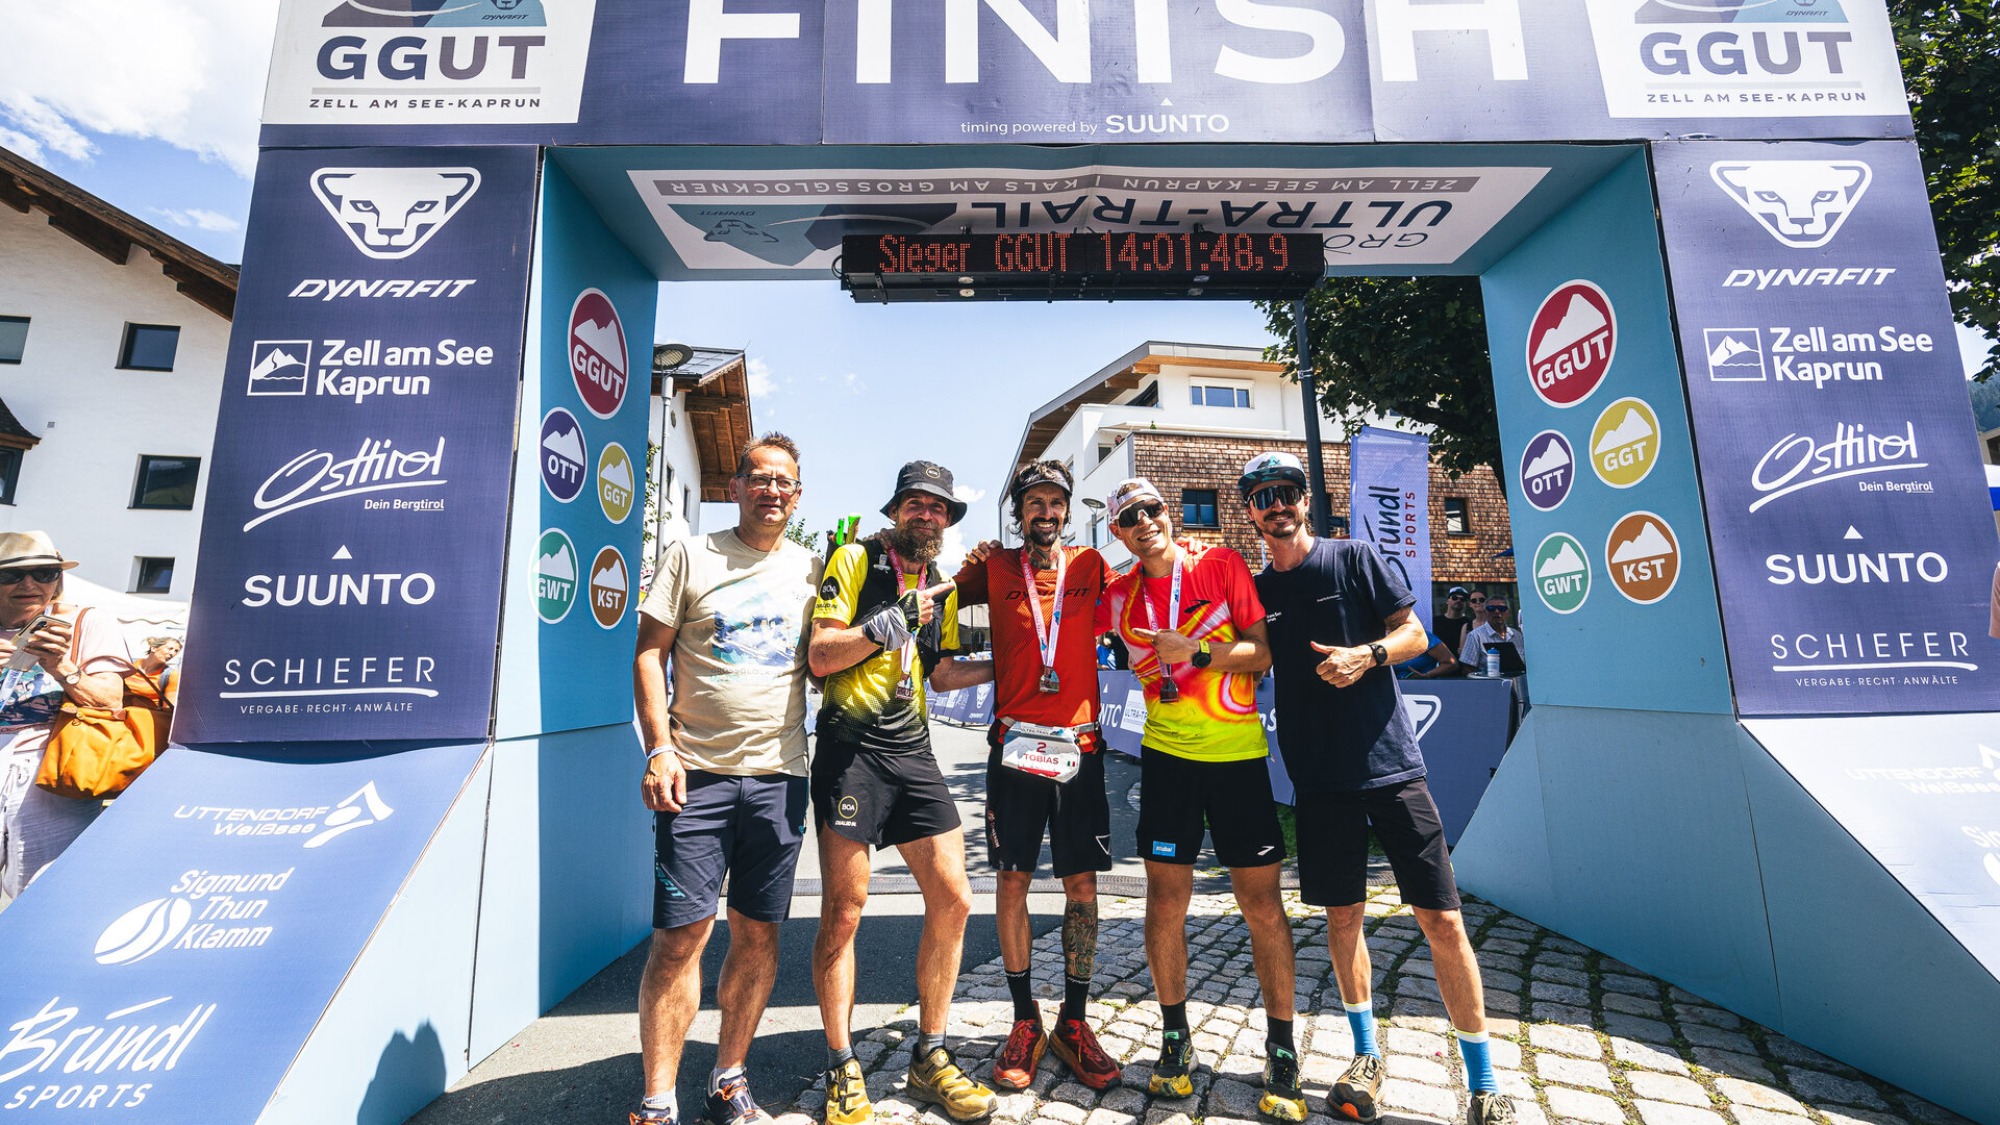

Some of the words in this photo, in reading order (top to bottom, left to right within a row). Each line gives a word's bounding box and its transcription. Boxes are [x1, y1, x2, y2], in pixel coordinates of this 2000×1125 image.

[684, 0, 1528, 84] FINISH
[1640, 31, 1852, 75] GGUT
[316, 35, 546, 81] GGUT
[310, 98, 358, 109] ZELL
[369, 98, 398, 108] AM
[408, 98, 541, 108] SEE-KAPRUN
[1647, 94, 1693, 103] ZELL
[1703, 94, 1731, 103] AM
[1740, 92, 1867, 103] SEE-KAPRUN
[961, 119, 1007, 137] timing
[1012, 119, 1075, 137] powered
[1079, 119, 1098, 137] by
[1105, 114, 1229, 134] SUUNTO
[671, 180, 934, 195] GROSSGLOCKNER
[949, 180, 990, 193] AM
[1005, 177, 1077, 193] KALS
[1122, 177, 1318, 191] SEE-KAPRUN
[1332, 178, 1375, 190] AM
[1387, 178, 1457, 191] ZELL
[972, 196, 1453, 229] ULTRA-TRAIL
[879, 234, 971, 273] Sieger
[995, 233, 1070, 272] GGUT
[288, 279, 477, 301] DYNAFIT
[1721, 267, 1896, 291] DYNAFIT
[1770, 327, 1828, 352] Zell
[1833, 331, 1877, 352] am
[1881, 326, 1933, 352] See
[319, 340, 379, 366] Zell
[384, 345, 431, 365] am
[436, 339, 493, 366] See
[1536, 335, 1610, 391] GGUT
[572, 344, 625, 403] GGUT
[1771, 355, 1883, 389] Kaprun
[315, 368, 431, 403] Kaprun
[1603, 441, 1648, 471] GGT
[548, 455, 579, 484] OTT
[1531, 469, 1565, 495] OTT
[603, 488, 628, 509] GGT
[1859, 481, 1883, 492] Dein
[1886, 481, 1933, 494] Bergtirol
[365, 499, 390, 511] Dein
[393, 499, 444, 513] Bergtirol
[1405, 492, 1417, 558] SPORTS
[1622, 558, 1665, 584] KST
[1766, 552, 1948, 584] SUUNTO
[242, 571, 435, 606] SUUNTO
[535, 575, 571, 601] GWT
[1543, 574, 1583, 597] GWT
[597, 589, 621, 610] KST
[1771, 632, 1969, 659] SCHIEFER
[224, 656, 435, 686] SCHIEFER
[1024, 753, 1059, 765] TOBIAS
[1036, 742, 1047, 753] 2
[174, 805, 330, 821] UTTENDORF
[841, 803, 855, 811] BOA
[170, 866, 296, 900] Sigmund
[198, 895, 269, 920] Thun
[173, 923, 273, 950] Klamm
[4, 1083, 153, 1109] SPORTS
